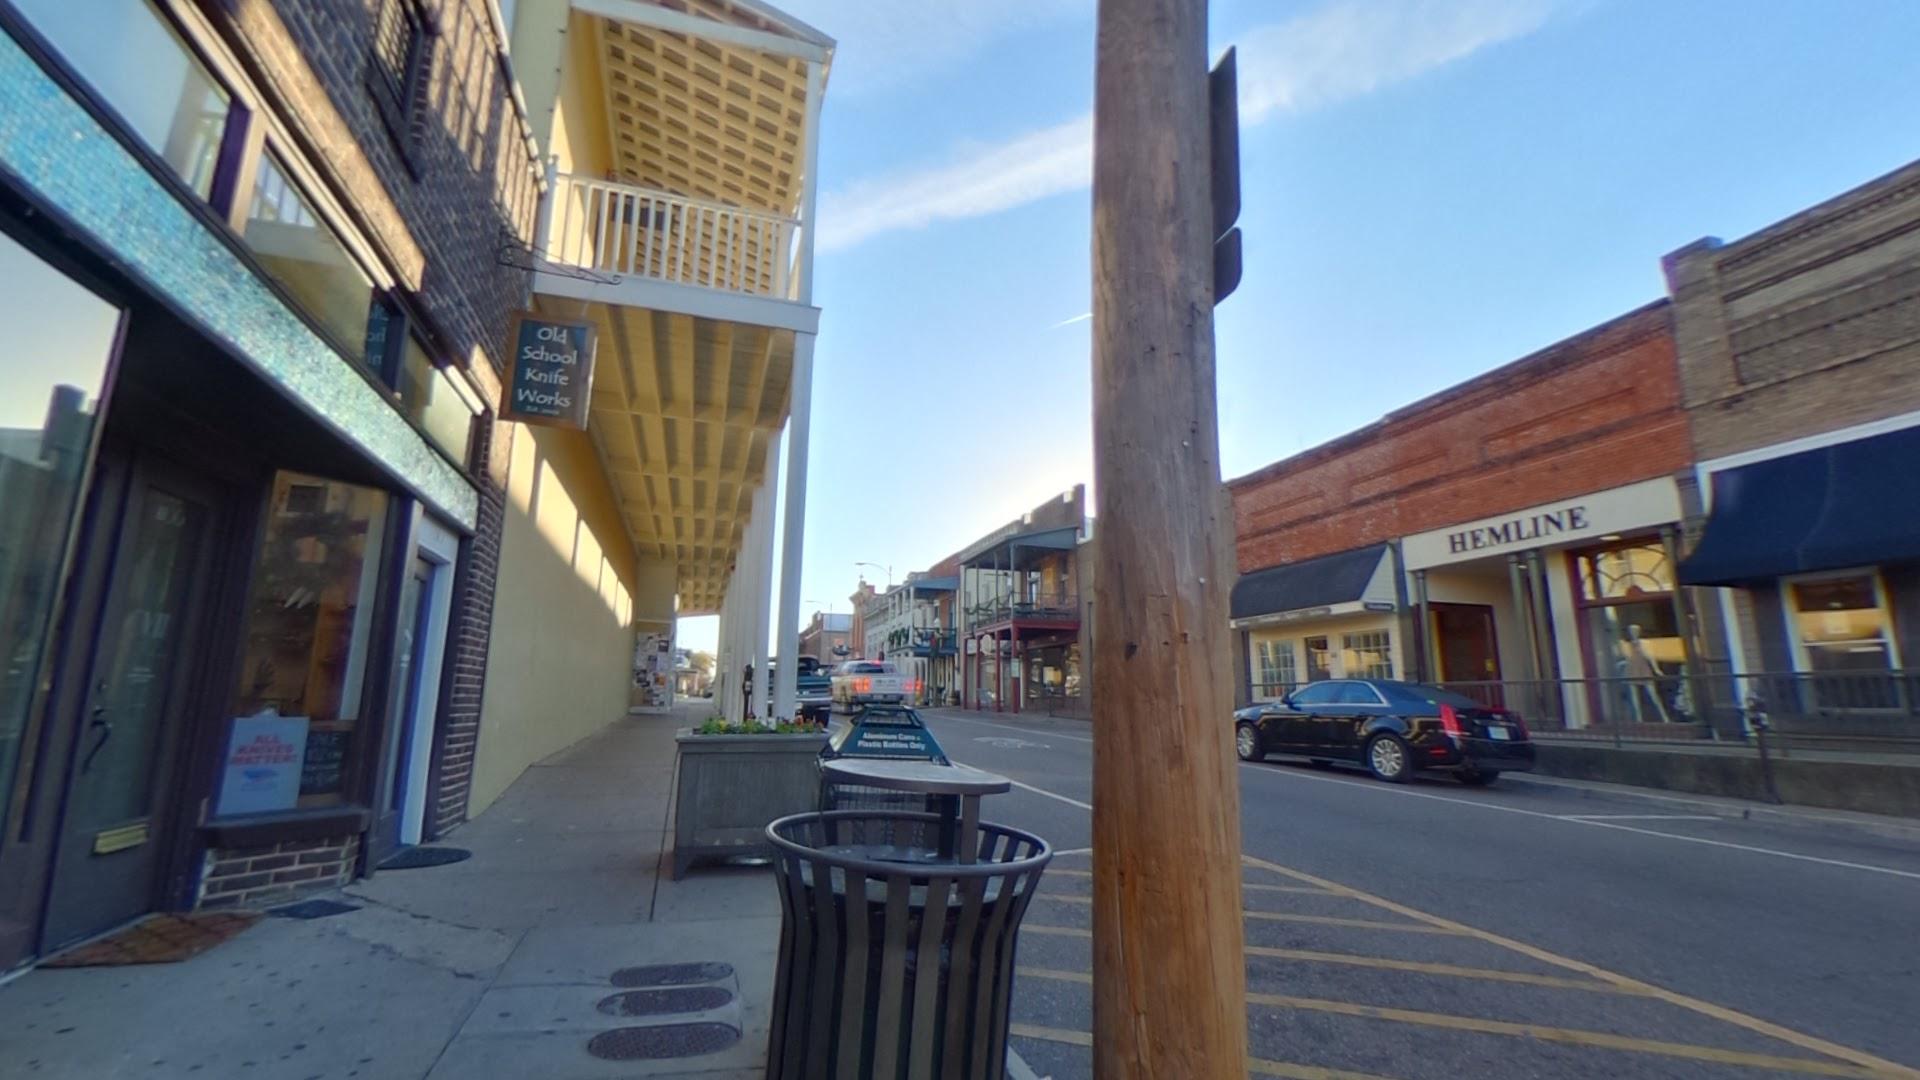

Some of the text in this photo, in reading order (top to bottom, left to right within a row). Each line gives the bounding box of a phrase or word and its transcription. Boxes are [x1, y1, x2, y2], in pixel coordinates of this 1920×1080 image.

[537, 327, 567, 344] Old
[522, 345, 578, 365] School
[525, 368, 569, 385] Knife
[518, 388, 572, 408] Works
[1448, 506, 1589, 553] HEMLINE
[862, 732, 898, 740] Aluminum
[898, 733, 916, 741] Cans
[857, 740, 926, 751] Plastic Bottles Only
